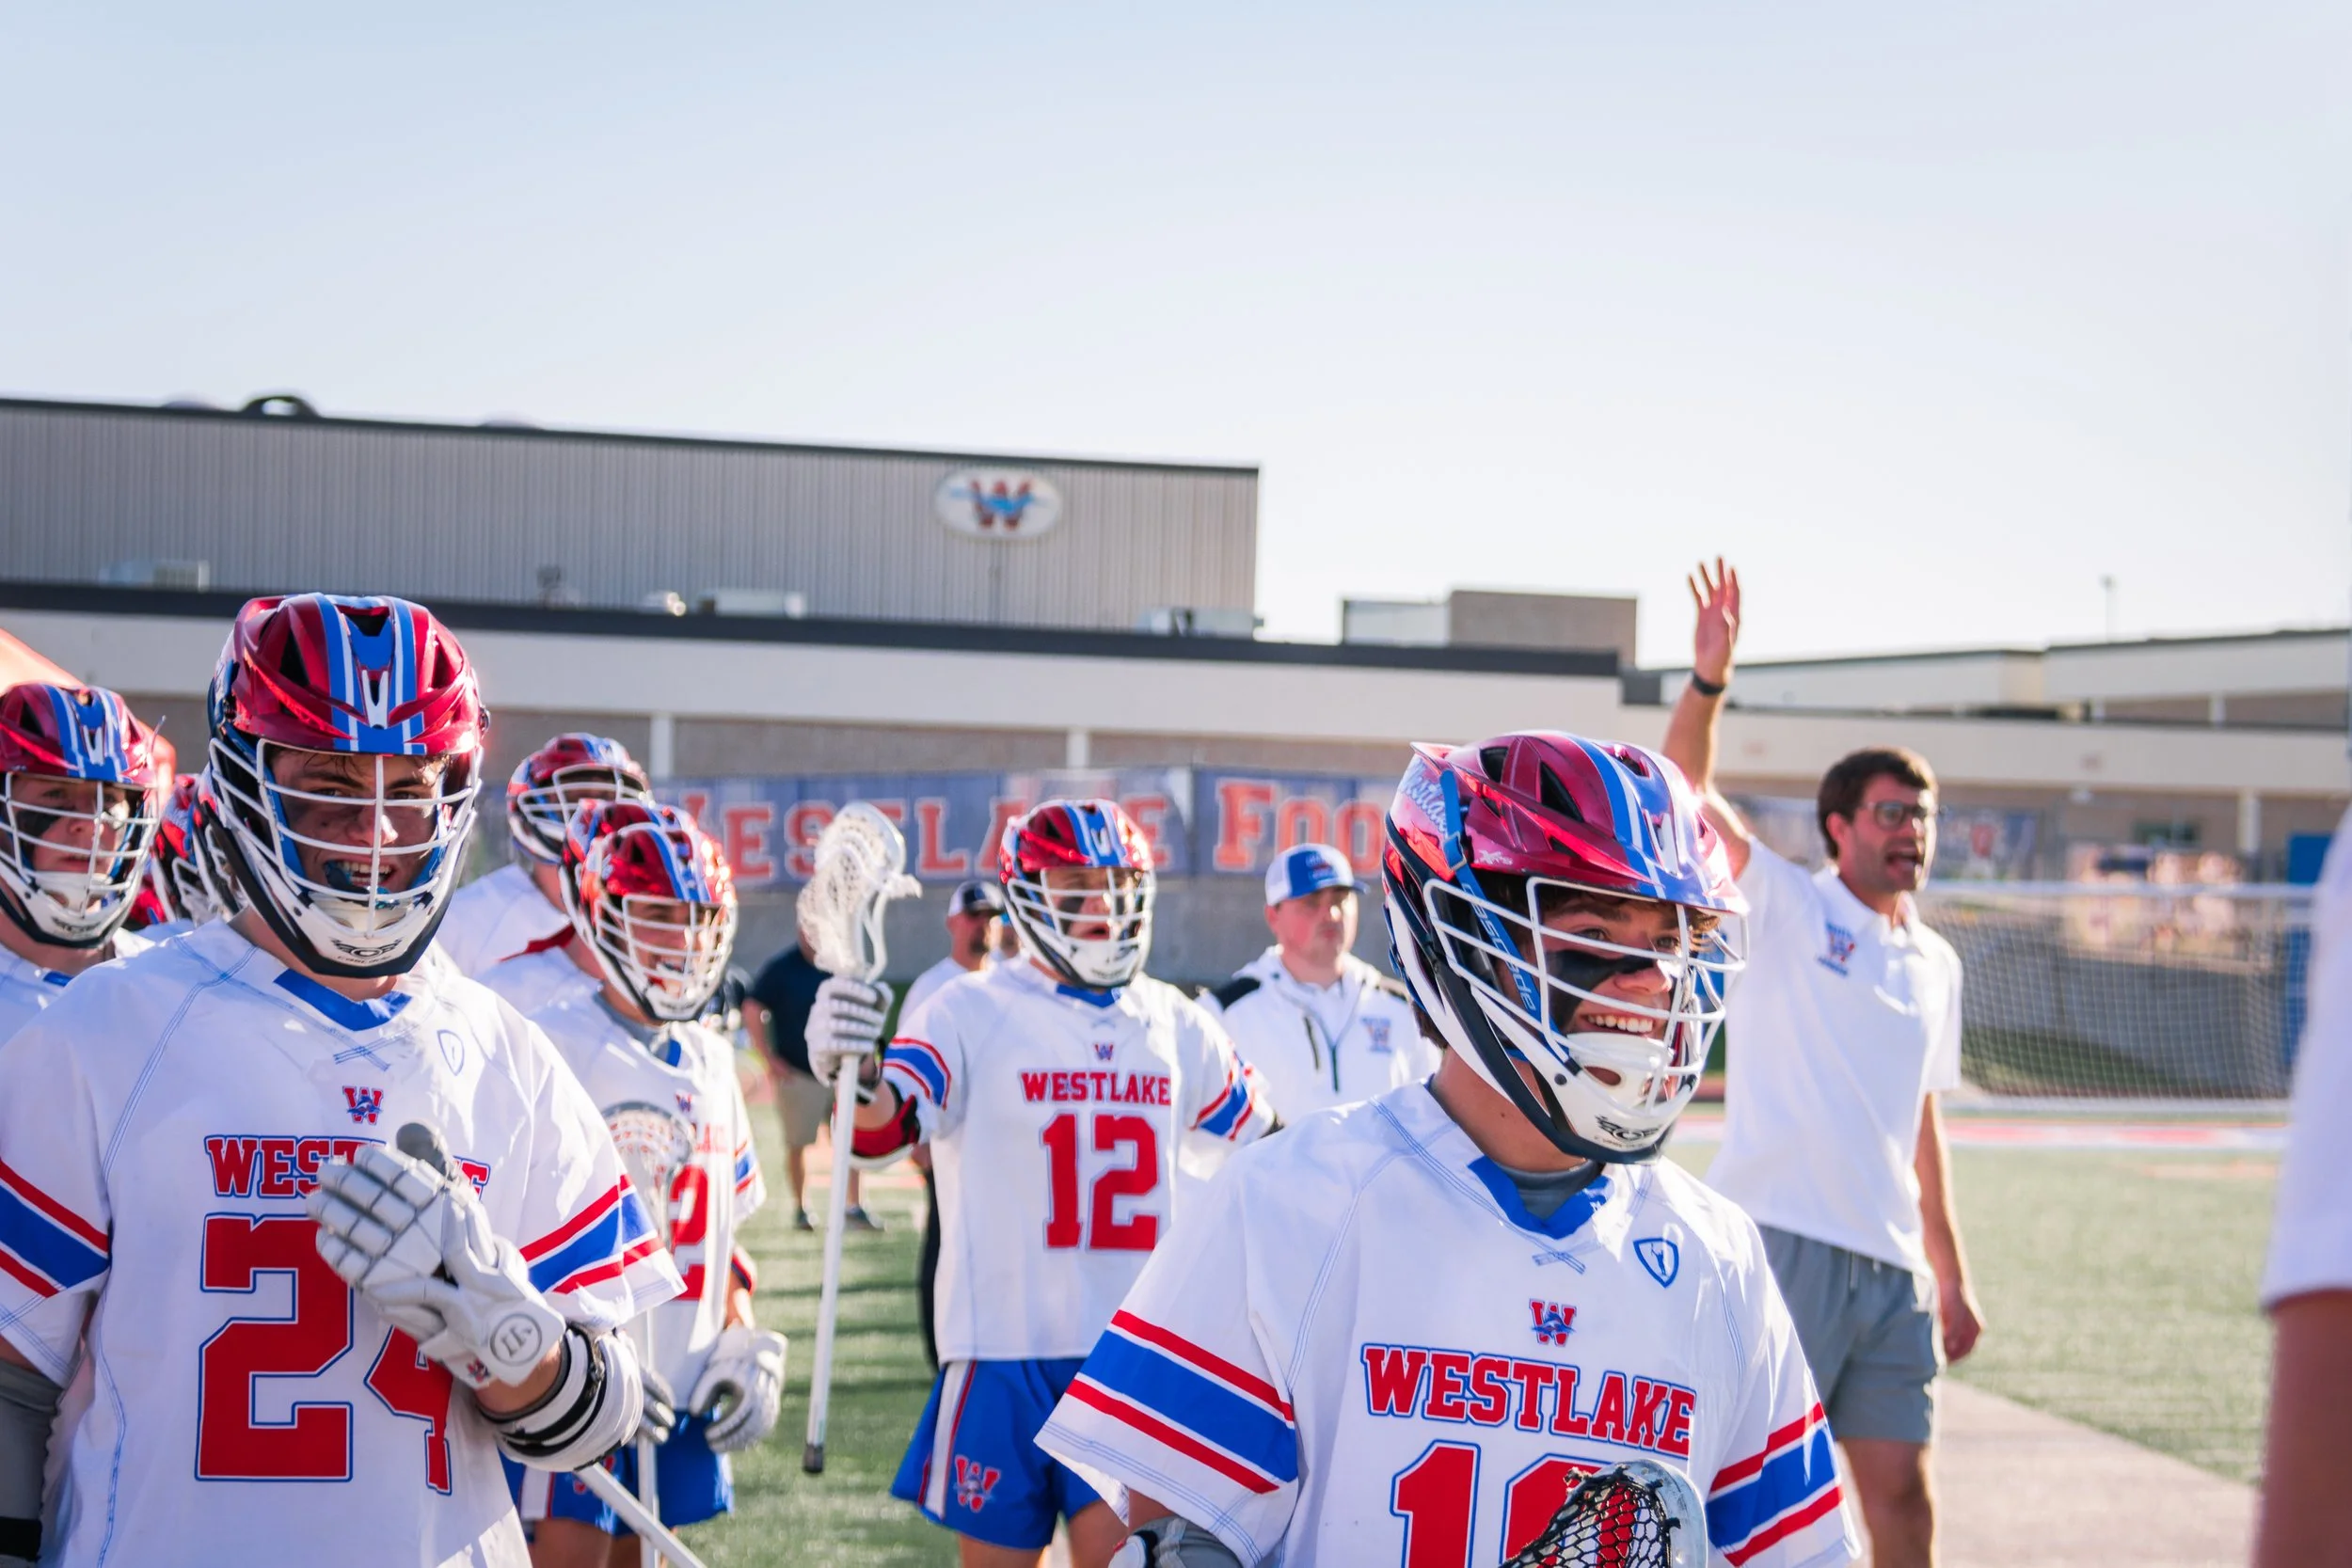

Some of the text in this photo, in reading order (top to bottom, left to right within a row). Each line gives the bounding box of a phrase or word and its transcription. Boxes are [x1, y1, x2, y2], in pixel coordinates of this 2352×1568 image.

[969, 480, 1033, 531] W
[342, 1085, 384, 1124] W
[1018, 1069, 1172, 1106] WESTLAKE
[1040, 1110, 1161, 1253] 12
[1529, 1299, 1578, 1347] W
[1360, 1343, 1697, 1460] WESTLAKE
[955, 1455, 1001, 1513] W
